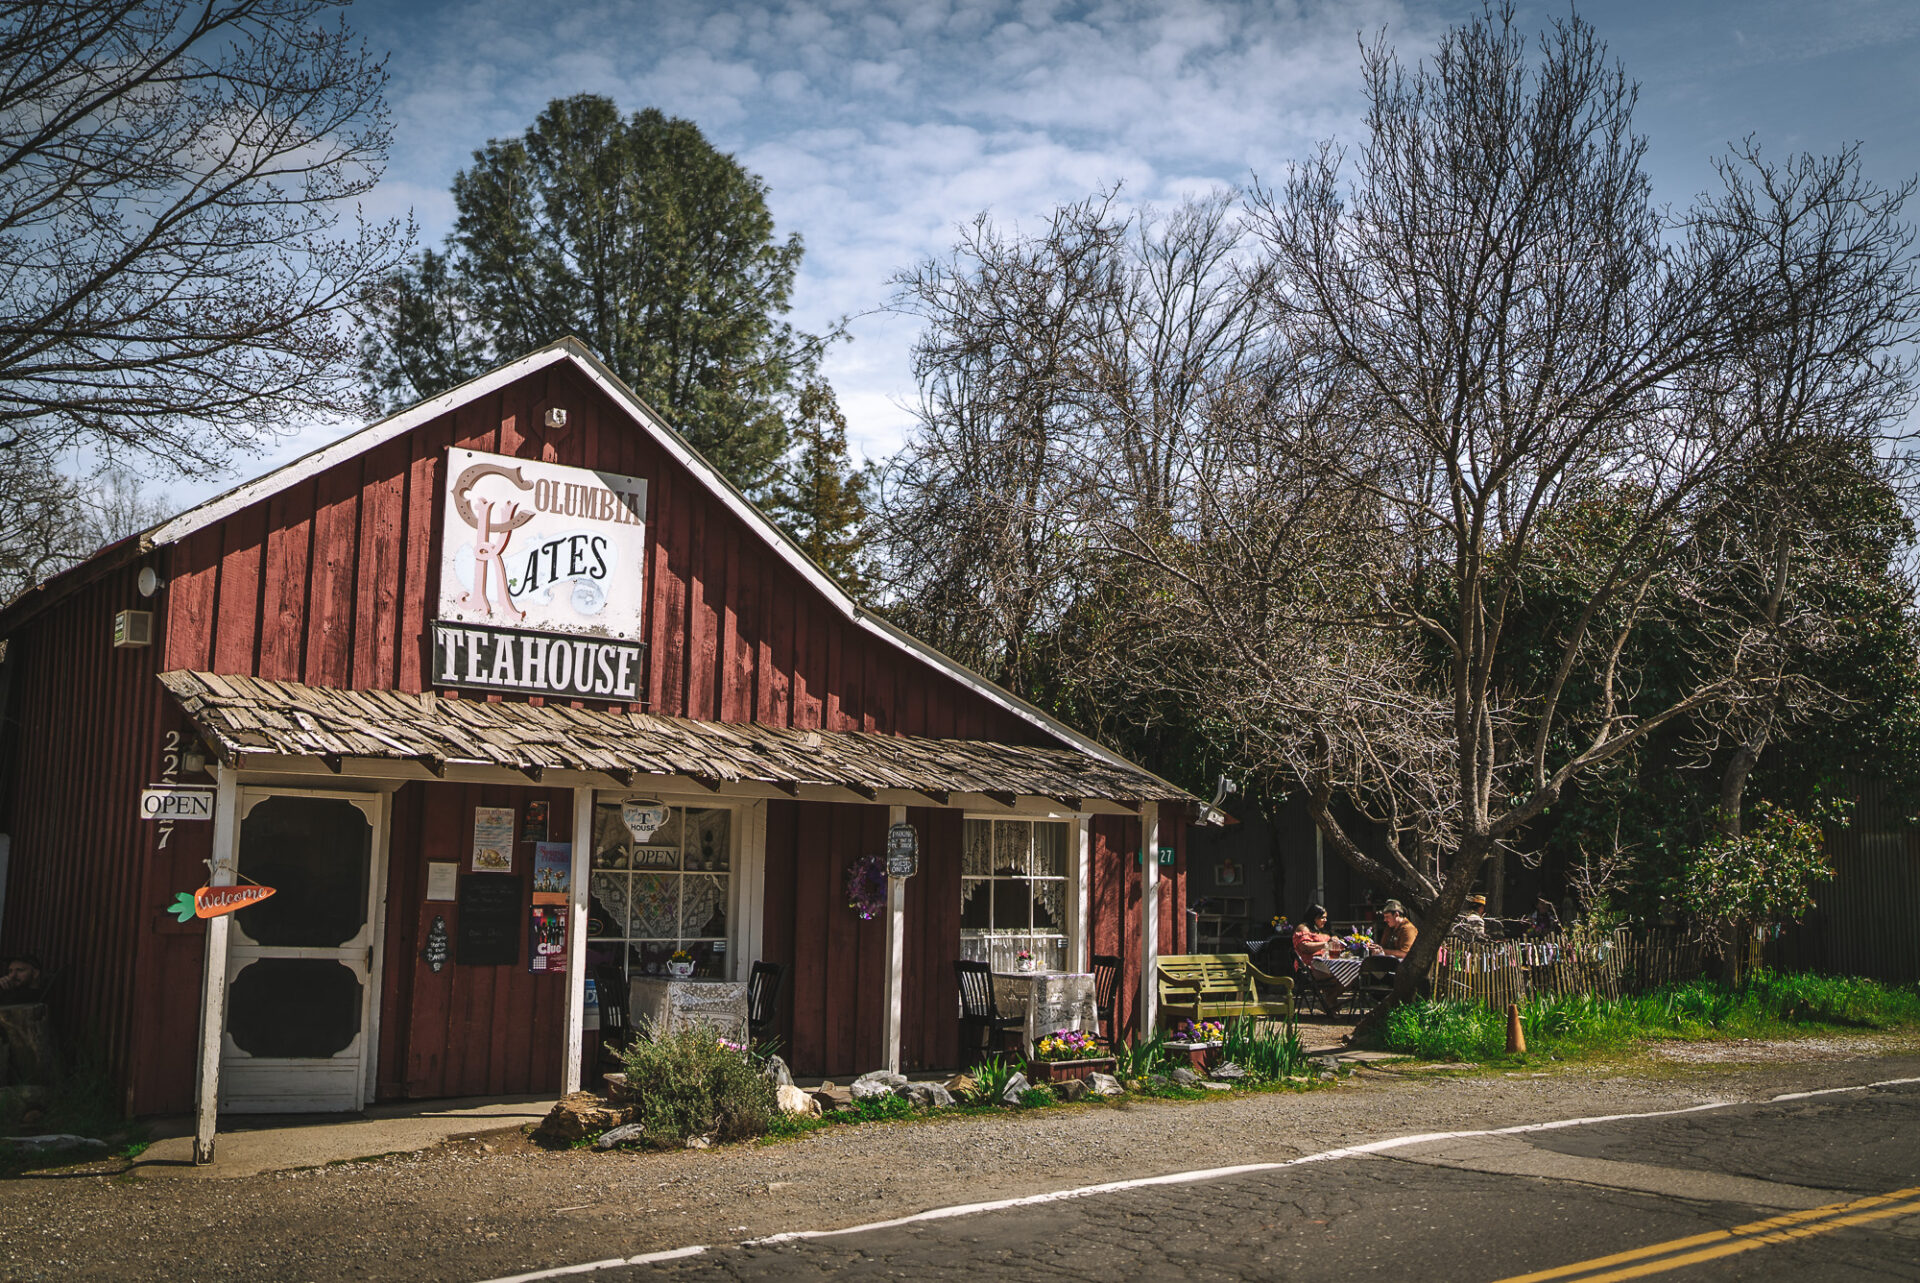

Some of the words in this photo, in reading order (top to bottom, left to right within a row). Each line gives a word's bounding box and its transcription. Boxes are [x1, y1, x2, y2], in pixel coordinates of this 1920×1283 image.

[450, 463, 641, 533] COLUMBIA
[457, 497, 608, 622] KATES
[438, 627, 640, 697] TEAHOUSE
[144, 795, 211, 815] OPEN
[631, 824, 655, 832] HOUSE
[638, 813, 650, 824] T
[634, 850, 677, 865] OPEN
[197, 886, 269, 910] Welcome
[537, 942, 562, 955] Clue
